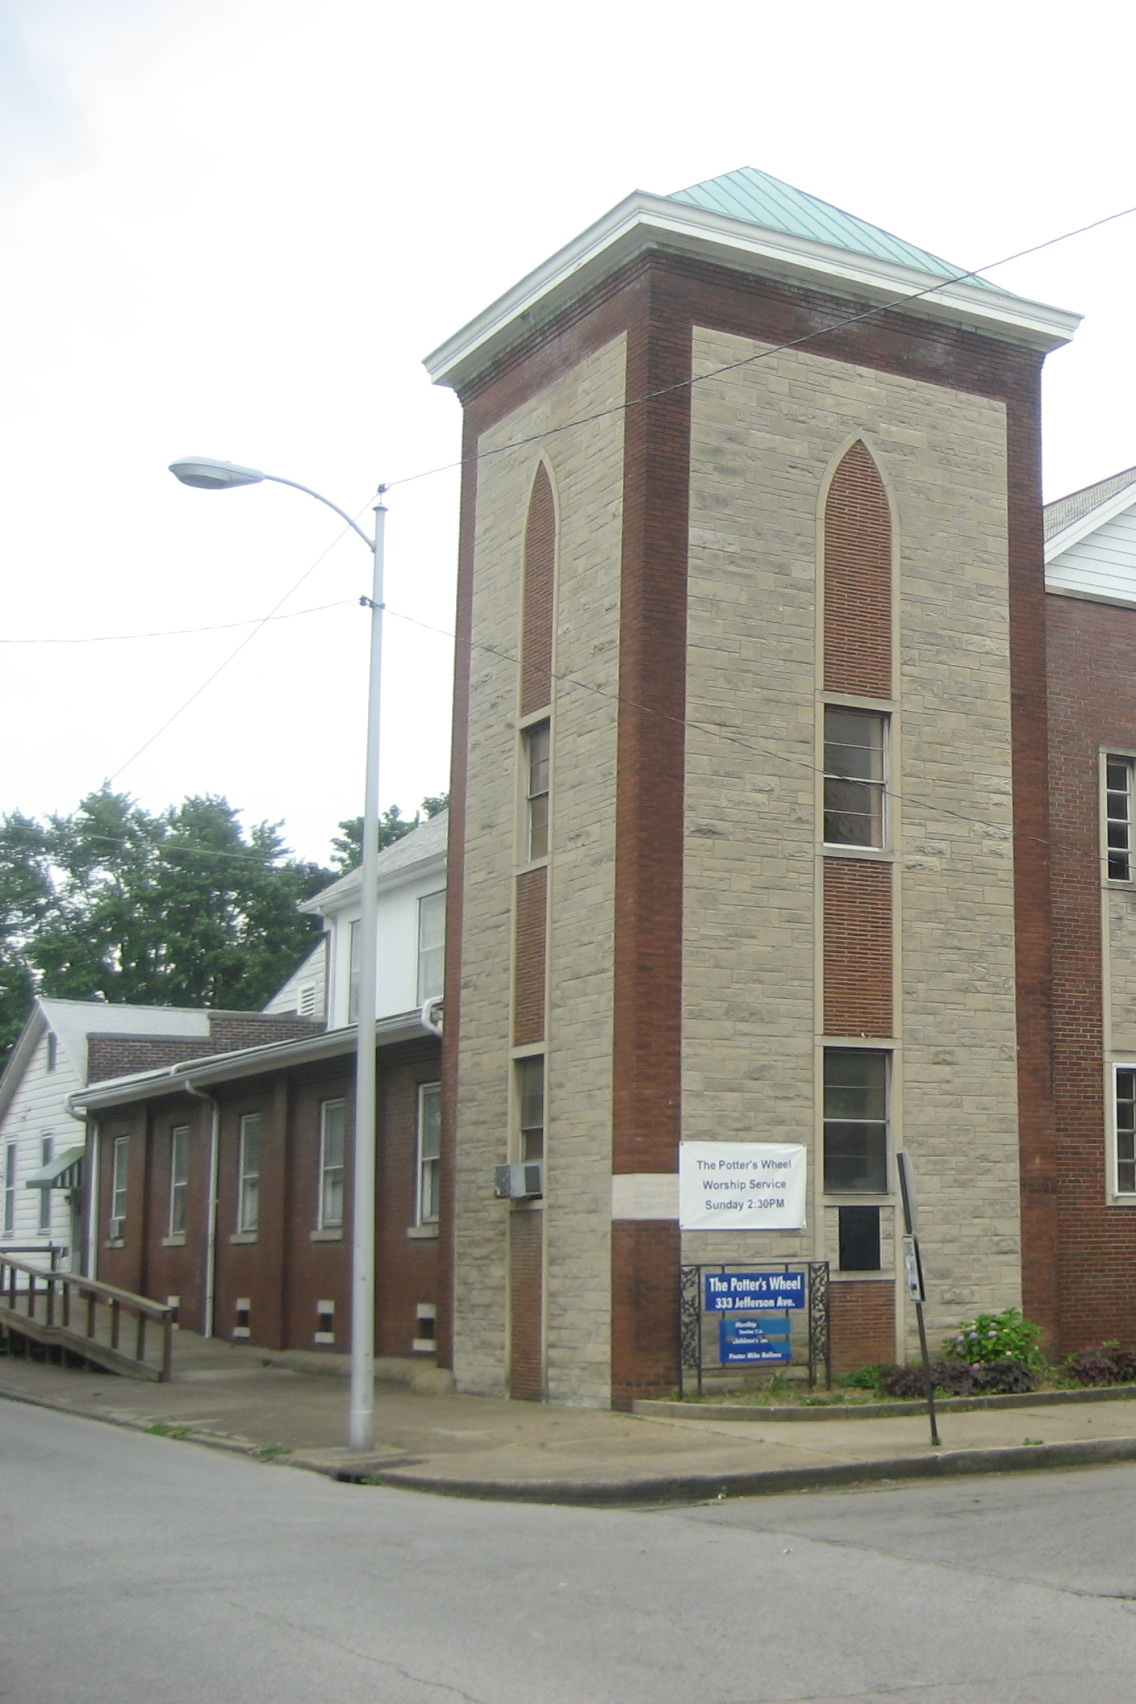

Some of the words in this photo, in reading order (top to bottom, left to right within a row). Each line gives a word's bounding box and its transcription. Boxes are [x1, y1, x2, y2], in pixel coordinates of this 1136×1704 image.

[697, 1160, 716, 1170] The
[718, 1160, 758, 1170] Potter's
[761, 1159, 791, 1169] Wheel
[703, 1180, 746, 1191] Worship
[749, 1179, 786, 1189] Service
[705, 1200, 744, 1211] Sunday
[747, 1199, 785, 1209] 2:30PM
[709, 1277, 728, 1292] The
[730, 1277, 767, 1291] Potter's
[769, 1275, 801, 1290] Wheel
[715, 1297, 733, 1309] 333
[734, 1296, 774, 1308] Jefferson
[776, 1296, 795, 1307] Ave.
